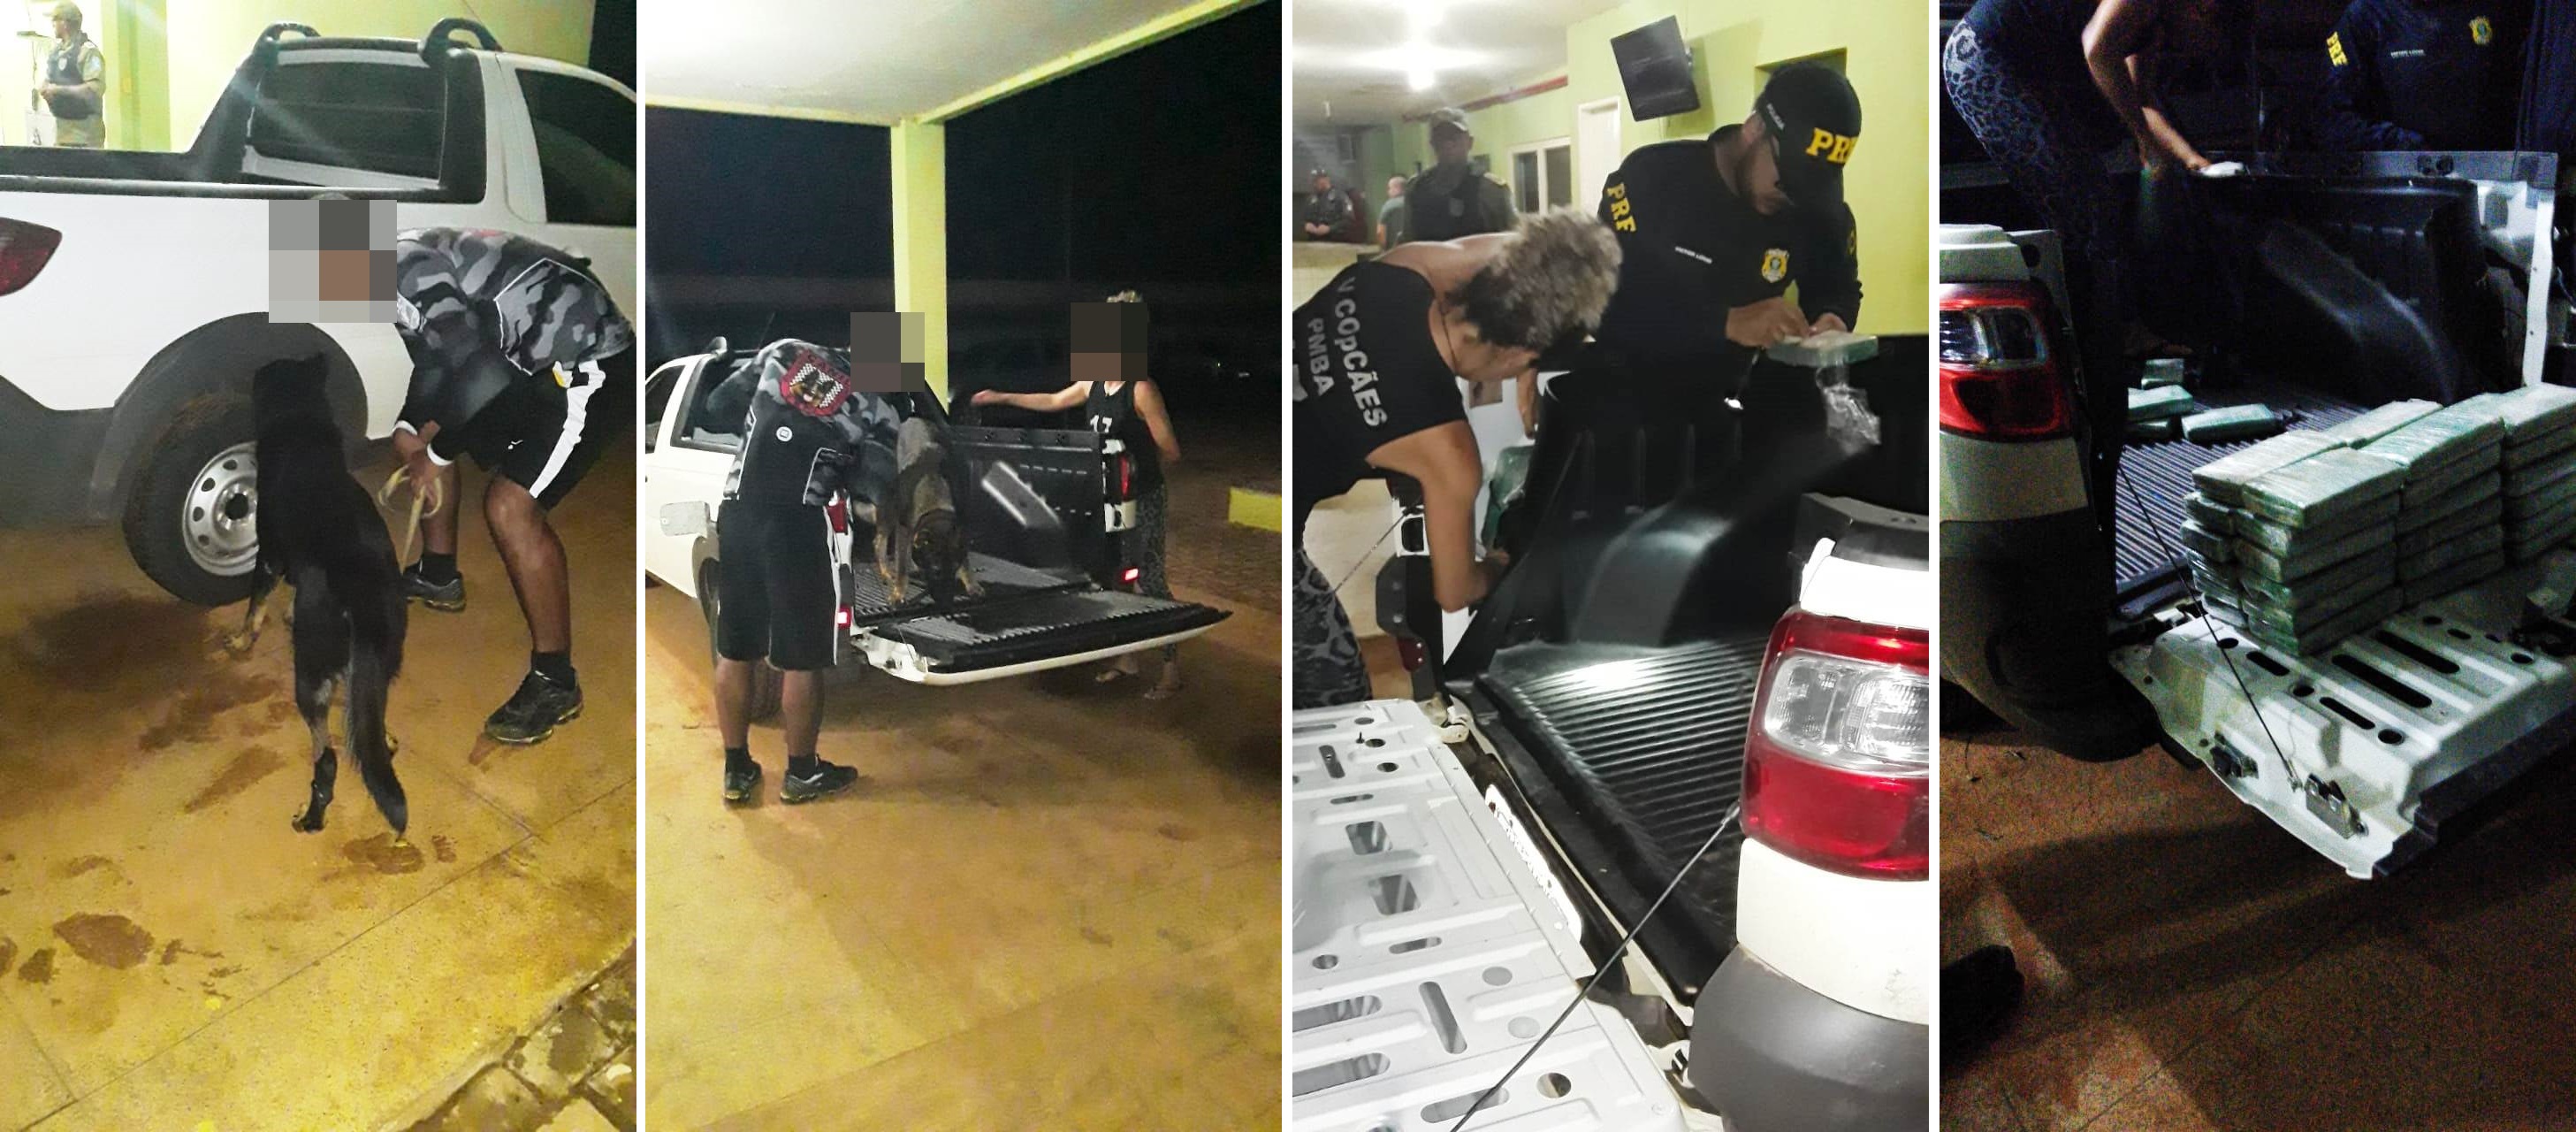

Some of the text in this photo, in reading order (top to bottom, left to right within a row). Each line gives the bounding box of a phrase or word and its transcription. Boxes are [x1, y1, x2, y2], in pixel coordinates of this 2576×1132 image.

[2326, 31, 2348, 66] PRF
[1607, 182, 1637, 232] PRF
[1307, 317, 1335, 397] PMBA
